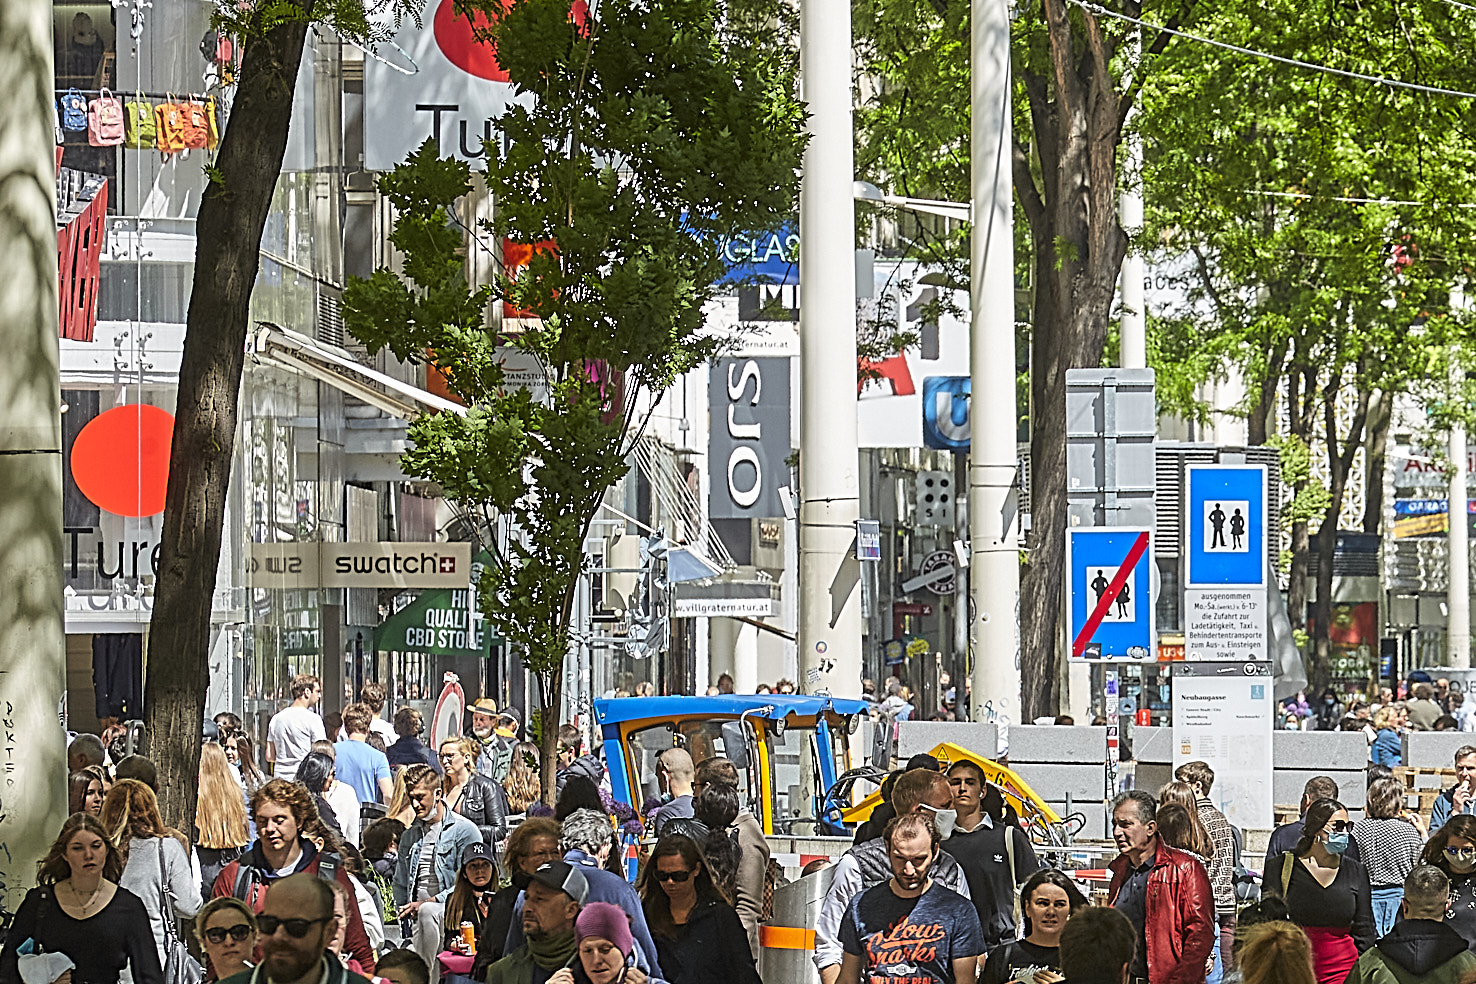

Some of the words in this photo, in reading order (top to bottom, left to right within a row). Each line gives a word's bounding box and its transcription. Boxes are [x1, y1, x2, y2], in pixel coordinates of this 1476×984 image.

[1409, 502, 1448, 511] GARAG
[336, 553, 437, 573] swatch
[1201, 593, 1251, 601] ausgenommen
[1240, 622, 1253, 630] Taxi
[406, 628, 433, 647] CBD
[1189, 631, 1263, 640] Behindertentransporte
[1227, 641, 1261, 650] Einsteigen
[1217, 650, 1235, 658] sowie
[1181, 694, 1227, 702] Neubaugasse
